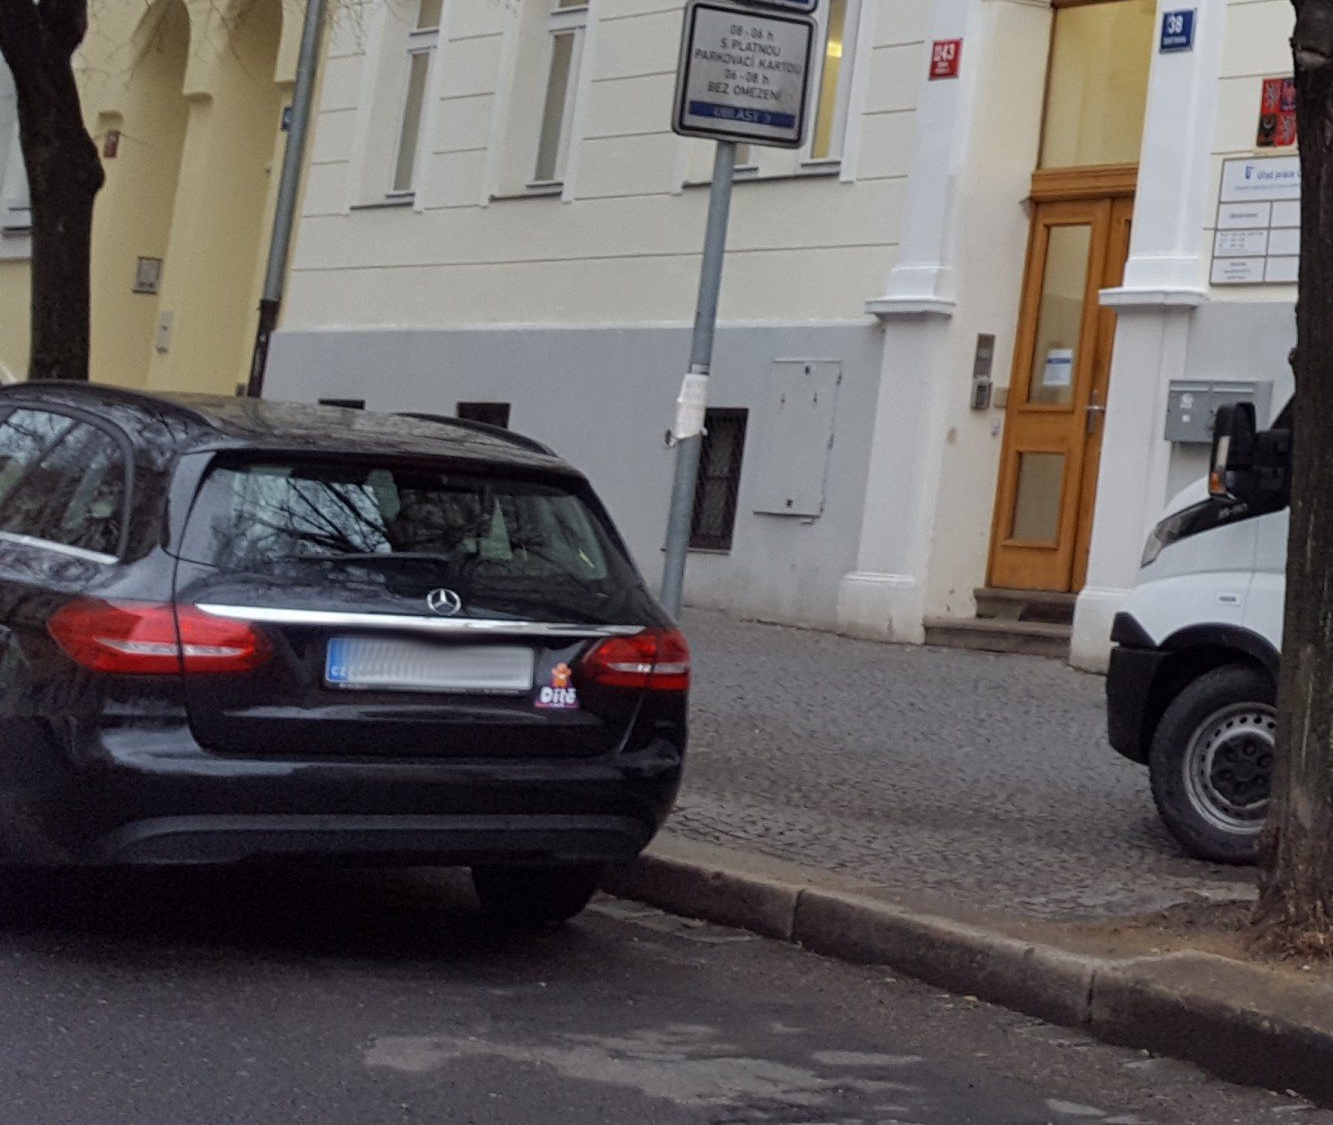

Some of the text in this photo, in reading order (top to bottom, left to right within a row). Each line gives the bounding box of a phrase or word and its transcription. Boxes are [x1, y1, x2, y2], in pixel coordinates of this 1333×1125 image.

[720, 37, 781, 57] S PLATNOU
[694, 48, 802, 75] PARKOVACÍ KARTOU
[707, 81, 729, 95] BEZ
